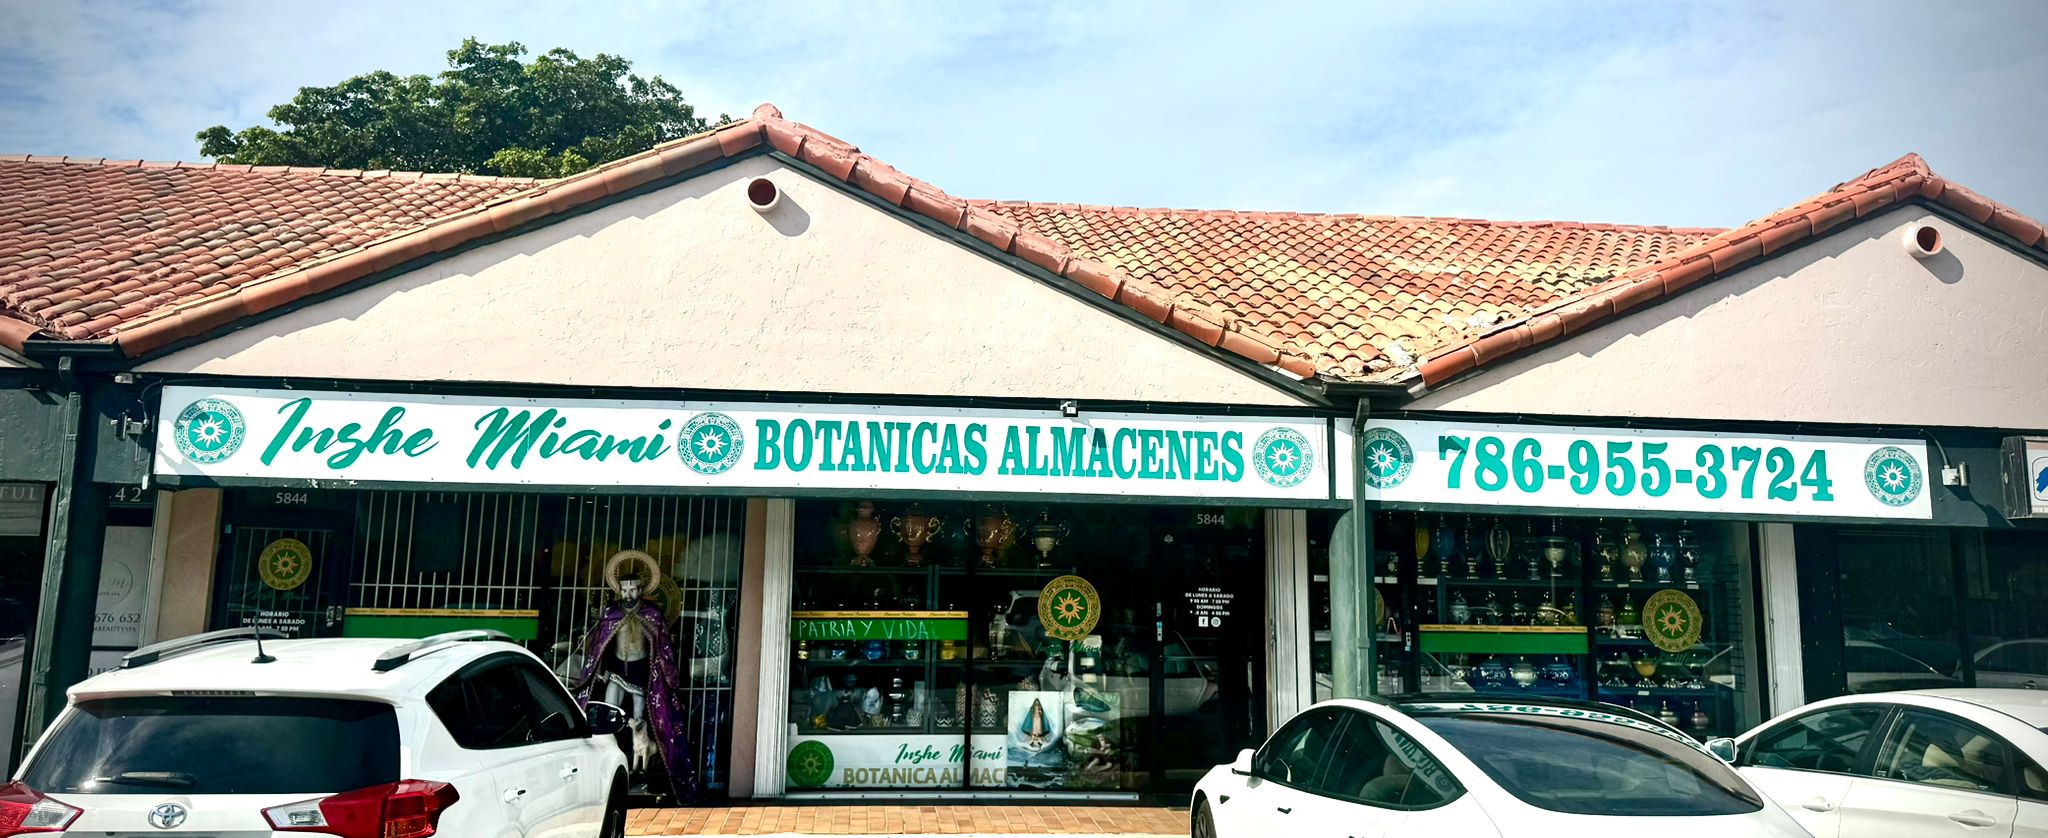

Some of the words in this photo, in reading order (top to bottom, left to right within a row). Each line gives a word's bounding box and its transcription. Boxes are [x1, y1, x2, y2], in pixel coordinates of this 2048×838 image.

[260, 396, 440, 471] Inshe
[466, 406, 672, 471] Miami
[753, 418, 988, 477] BOTANICAS
[997, 424, 1245, 484] ALMACENES
[1436, 434, 1835, 503] 786-955-3724
[275, 492, 308, 505] 5844
[1196, 513, 1225, 525] 5844
[860, 620, 873, 637] Y
[894, 743, 942, 765] Inshe
[843, 767, 937, 785] BOTANICA
